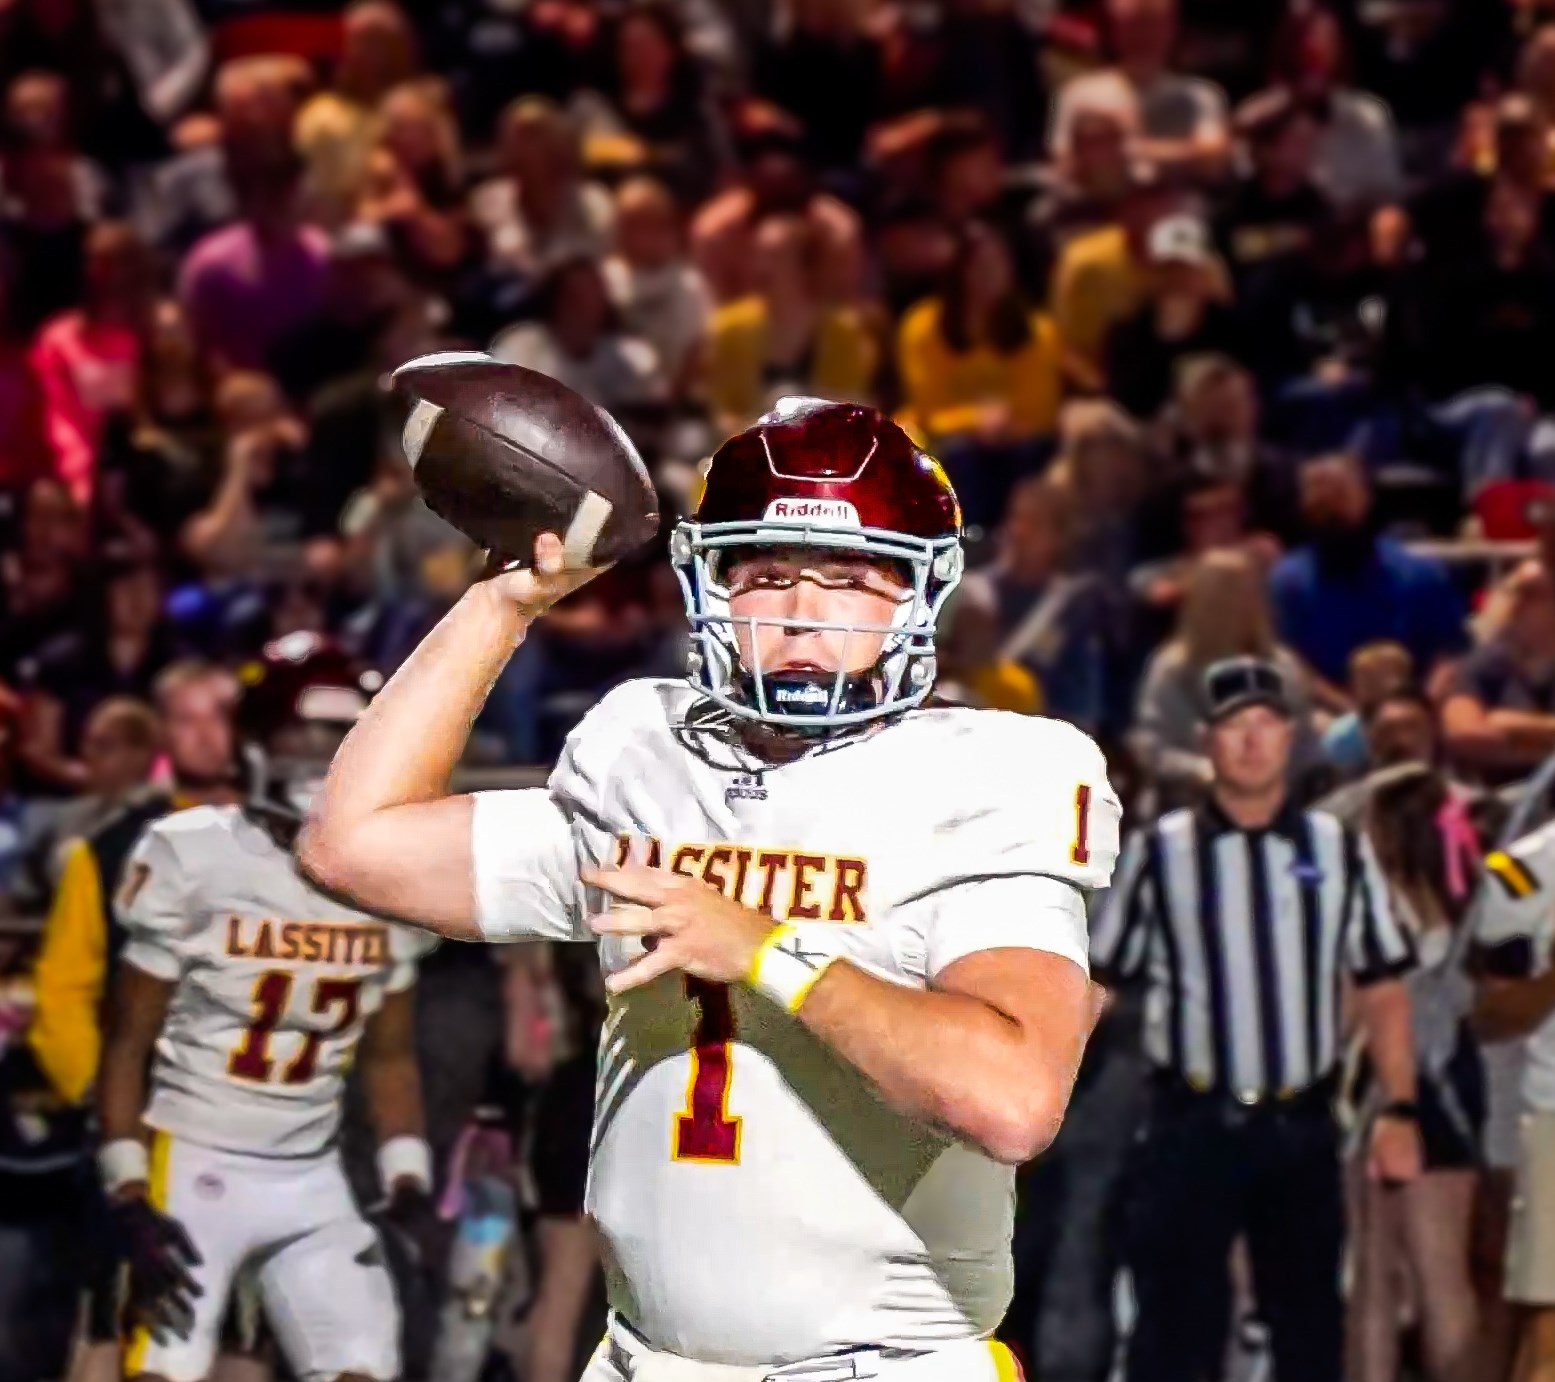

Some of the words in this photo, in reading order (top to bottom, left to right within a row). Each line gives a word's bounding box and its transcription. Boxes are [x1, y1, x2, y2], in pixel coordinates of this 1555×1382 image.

[1070, 783, 1091, 866] 1
[226, 968, 362, 1083] 17
[671, 973, 742, 1164] 1
